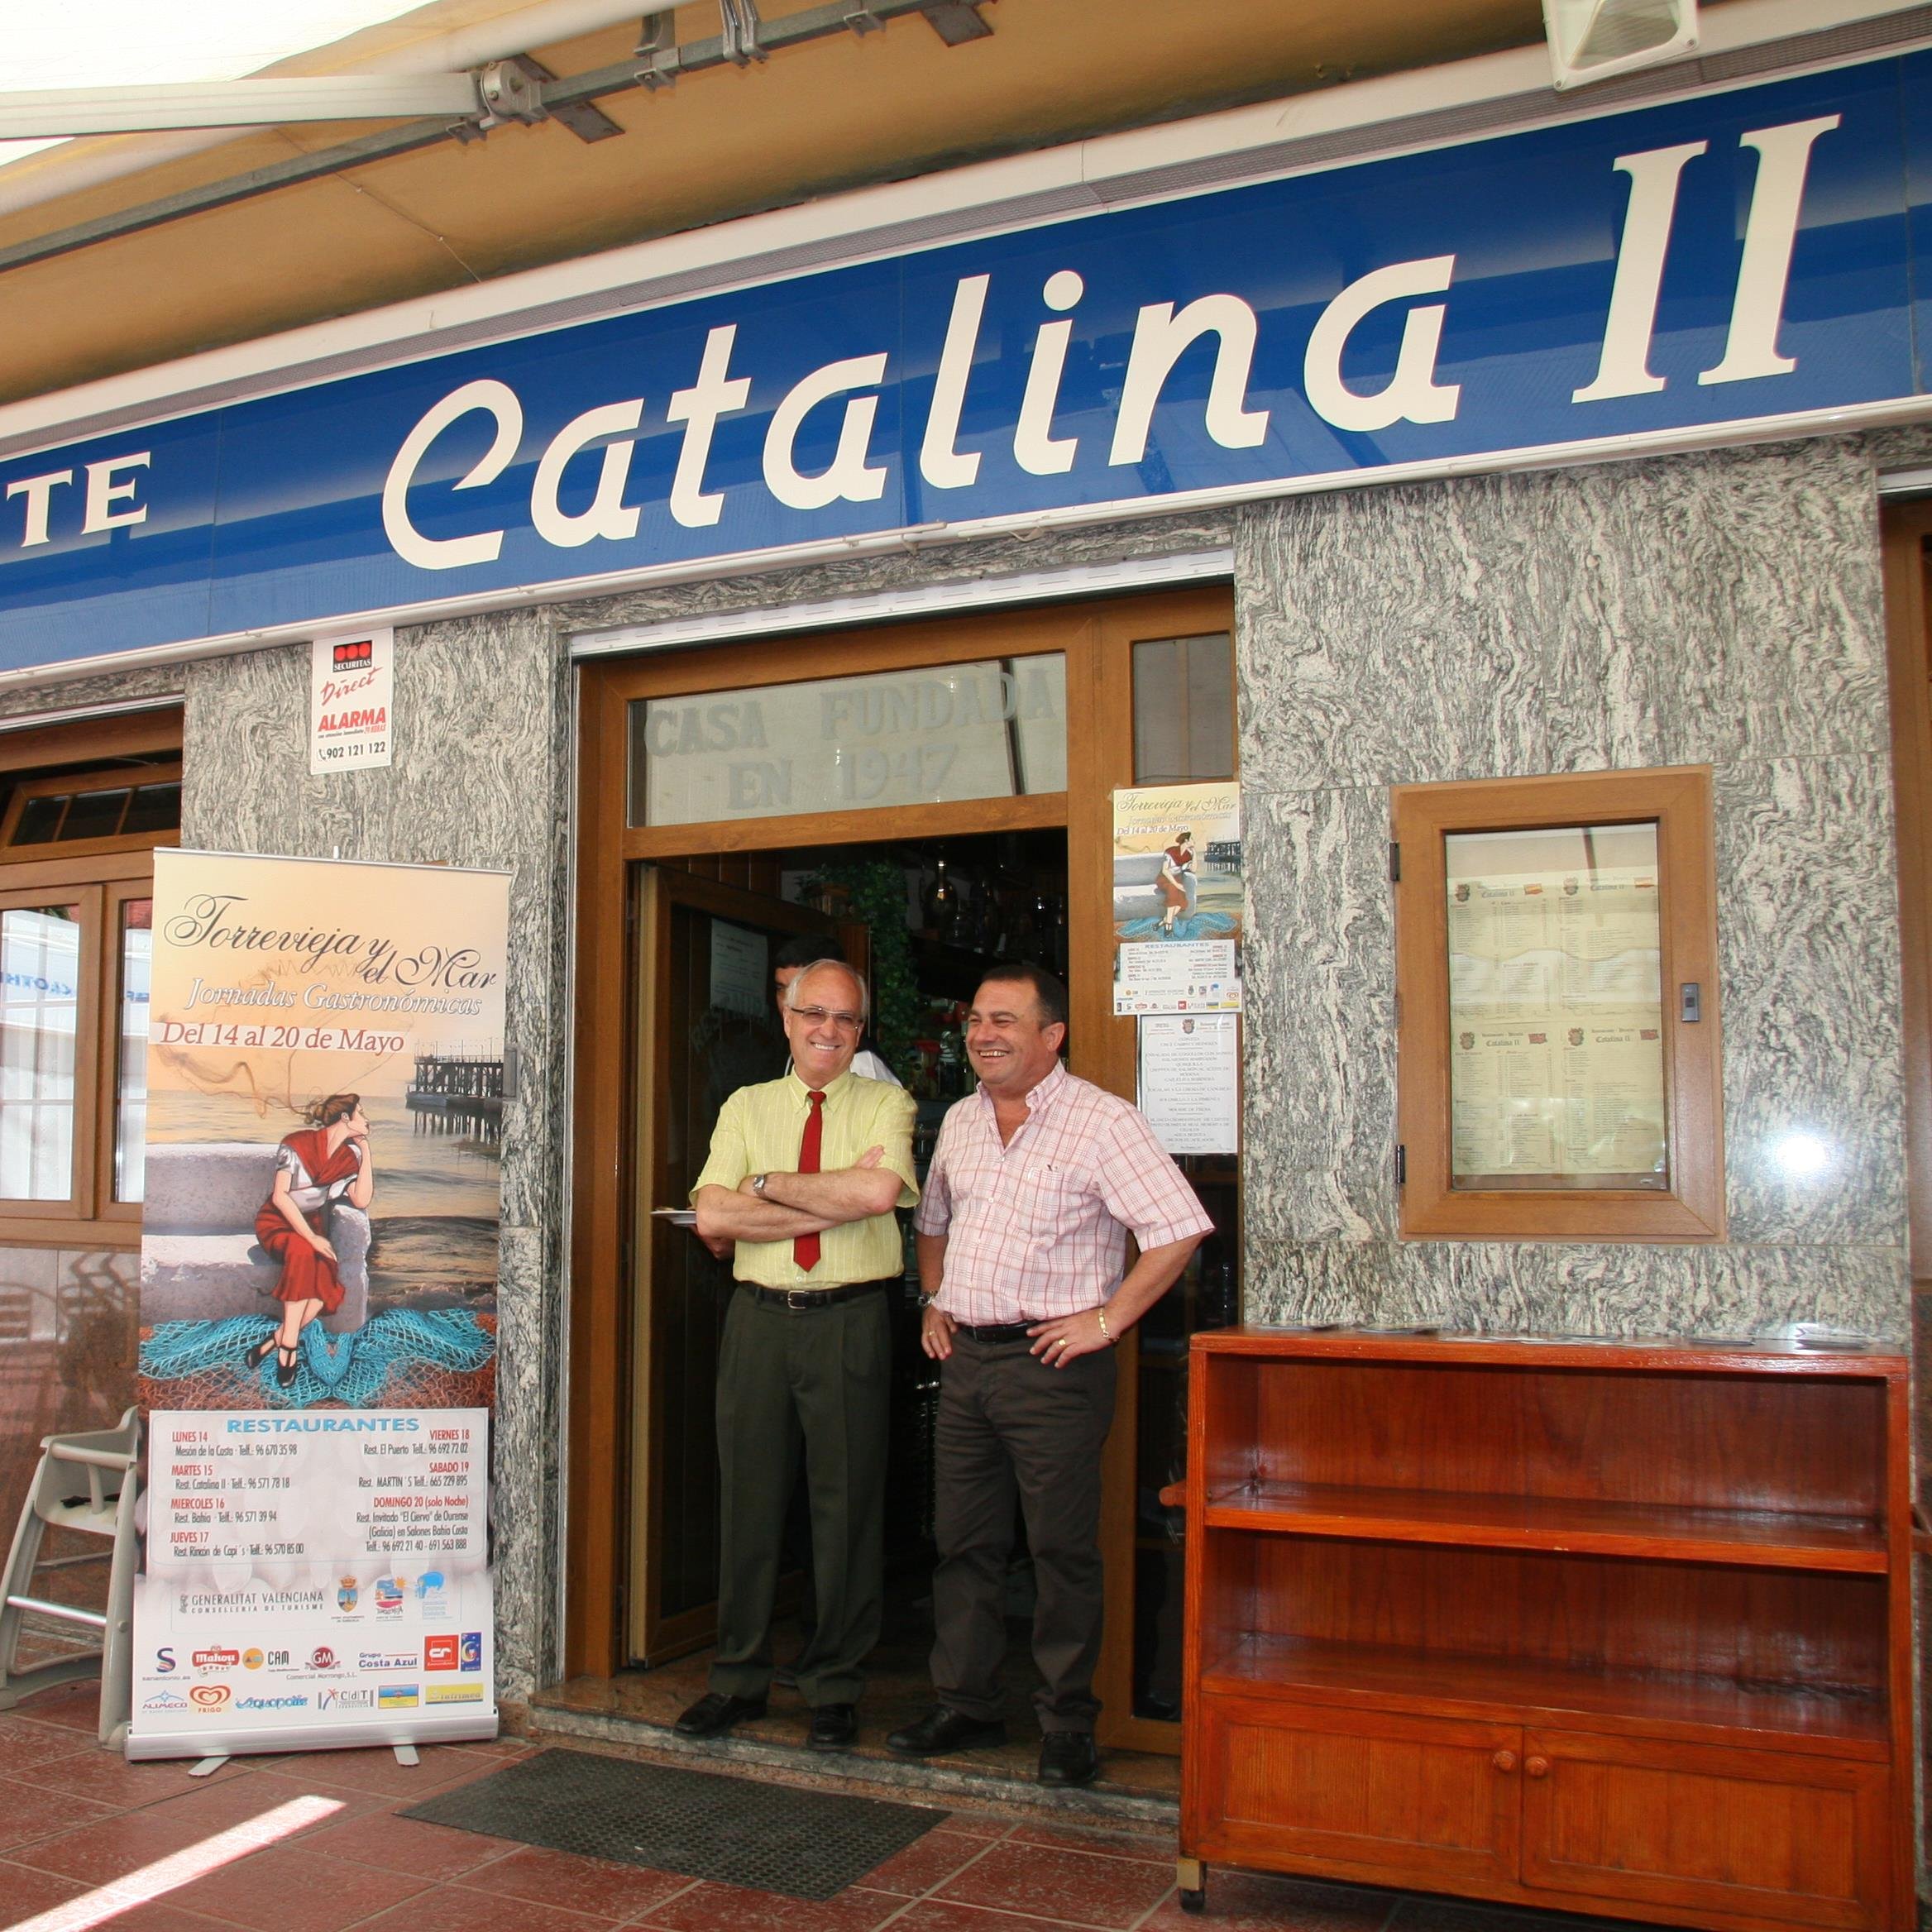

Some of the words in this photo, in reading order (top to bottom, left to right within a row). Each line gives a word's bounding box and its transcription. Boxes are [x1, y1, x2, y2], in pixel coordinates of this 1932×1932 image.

[7, 452, 152, 548] TE
[381, 254, 1461, 571] Catalina
[1571, 114, 1841, 405] II
[334, 659, 371, 671] SECURITAS
[320, 667, 382, 706] Direct
[644, 700, 769, 758] CASA
[820, 667, 1055, 740] FUNDADA
[318, 707, 386, 732] ALARMA
[327, 748, 344, 759] 902
[348, 744, 363, 756] 121
[369, 742, 385, 753] 122
[728, 758, 792, 810] EN
[834, 744, 959, 800] 1947
[1118, 792, 1182, 815] Torrevieja
[1201, 796, 1236, 811] Mar
[1169, 825, 1188, 833] Mayo
[164, 893, 367, 973] Torrevieja
[355, 936, 394, 973] y
[363, 949, 398, 985] el
[395, 945, 496, 989] Mar
[185, 978, 296, 1010] Jornadas
[304, 983, 482, 1016] Gastronómicas
[160, 1022, 204, 1044] Del
[213, 1024, 238, 1045] 14
[244, 1025, 265, 1046] al
[275, 1026, 299, 1047] 20
[305, 1027, 332, 1049] de
[338, 1030, 404, 1055] Mayo
[227, 1418, 419, 1432] RESTAURANTES
[173, 1432, 196, 1442] LUNES
[199, 1432, 208, 1442] 14
[430, 1430, 459, 1440] VIERNES
[462, 1429, 470, 1438] 18
[198, 1447, 207, 1456] de
[208, 1447, 214, 1456] la
[216, 1447, 233, 1456] Costa
[256, 1445, 264, 1455] 96
[380, 1445, 386, 1454] El
[388, 1445, 409, 1454] Puerto
[428, 1443, 437, 1454] 96
[438, 1443, 450, 1453] 692
[452, 1443, 459, 1453] 72
[460, 1442, 468, 1453] 02
[171, 1465, 201, 1475] MARTES
[204, 1465, 213, 1475] 15
[429, 1463, 458, 1473] SABADO
[461, 1462, 469, 1471] 19
[193, 1480, 220, 1489] Catalina
[222, 1480, 226, 1489] II
[248, 1478, 256, 1488] 96
[258, 1478, 270, 1488] 571
[282, 1477, 289, 1488] 18
[377, 1477, 403, 1486] MARTIN
[430, 1476, 442, 1486] 665
[171, 1499, 213, 1509] MIERCOLES
[216, 1499, 224, 1509] 16
[374, 1497, 412, 1507] DOMINGO
[414, 1497, 423, 1506] 20
[425, 1496, 442, 1509] (solo
[445, 1495, 468, 1509] Noche)
[236, 1512, 244, 1522] 96
[245, 1512, 258, 1522] 571
[260, 1512, 267, 1521] 39
[269, 1512, 276, 1521] 94
[373, 1513, 398, 1523] Invitado
[434, 1511, 442, 1520] de
[444, 1511, 468, 1520] Ourense
[170, 1532, 197, 1542] JUEVES
[200, 1532, 208, 1542] 17
[369, 1526, 395, 1539] (Galicia)
[397, 1528, 405, 1537] en
[407, 1527, 431, 1537] Salones
[452, 1526, 467, 1535] Costa
[213, 1546, 221, 1556] de
[265, 1544, 273, 1554] 96
[275, 1544, 286, 1554] 570
[382, 1541, 390, 1551] 96
[404, 1541, 413, 1550] 21
[414, 1540, 423, 1550] 40
[429, 1540, 441, 1550] 691
[442, 1540, 454, 1550] 563
[192, 1593, 256, 1605] GENERALITAT
[261, 1591, 323, 1603] VALENCIANA
[196, 1652, 236, 1663] Mahou
[267, 1651, 289, 1665] CAM
[313, 1652, 332, 1664] GM
[395, 1658, 417, 1667] Azul
